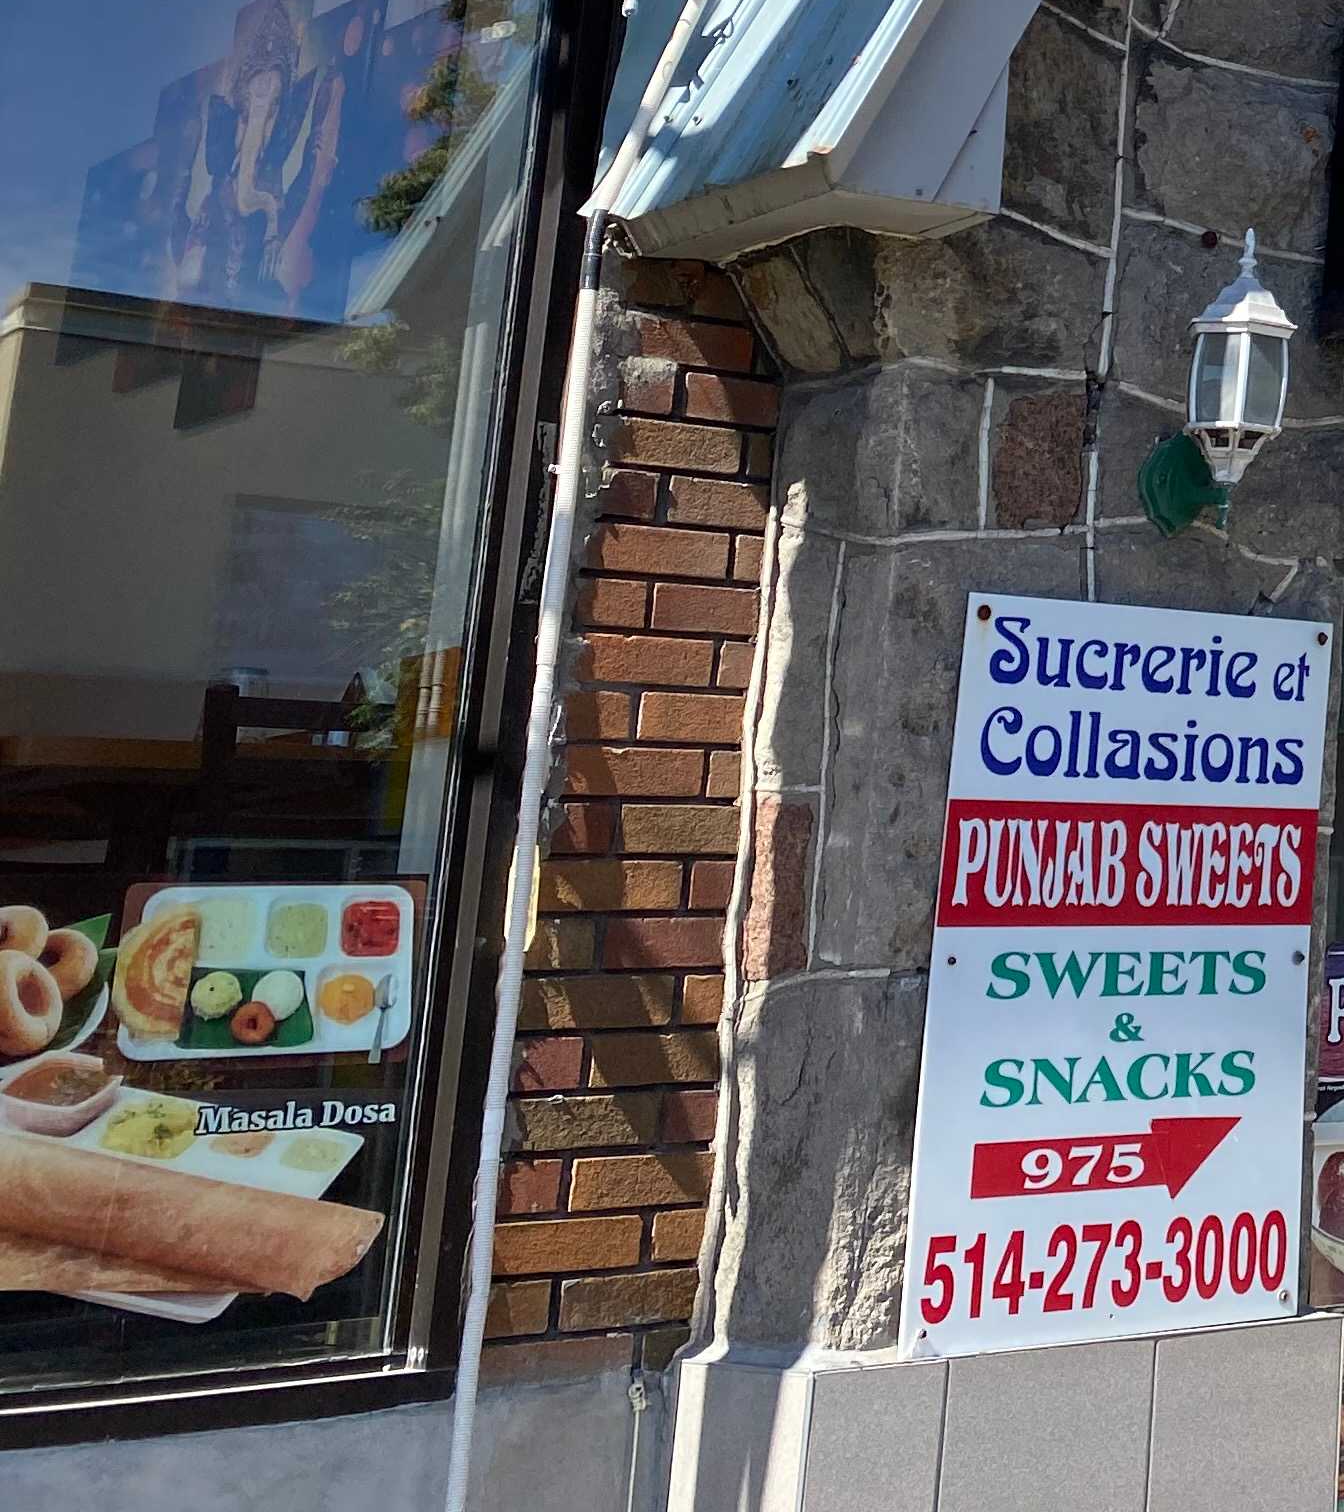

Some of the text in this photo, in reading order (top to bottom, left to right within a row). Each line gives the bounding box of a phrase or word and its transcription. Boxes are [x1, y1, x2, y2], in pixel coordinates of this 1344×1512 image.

[989, 616, 1310, 701] Sucrerie et
[980, 706, 1304, 785] Collasions
[951, 818, 1302, 908] PUNJAB SWEETS
[986, 950, 1266, 1000] SWEETS
[1109, 1012, 1145, 1042] &
[979, 1050, 1256, 1108] SNACKS
[194, 1099, 396, 1136] Masala Dosa
[1021, 1143, 1145, 1189] 975
[920, 1210, 1287, 1325] 514-273-3000
